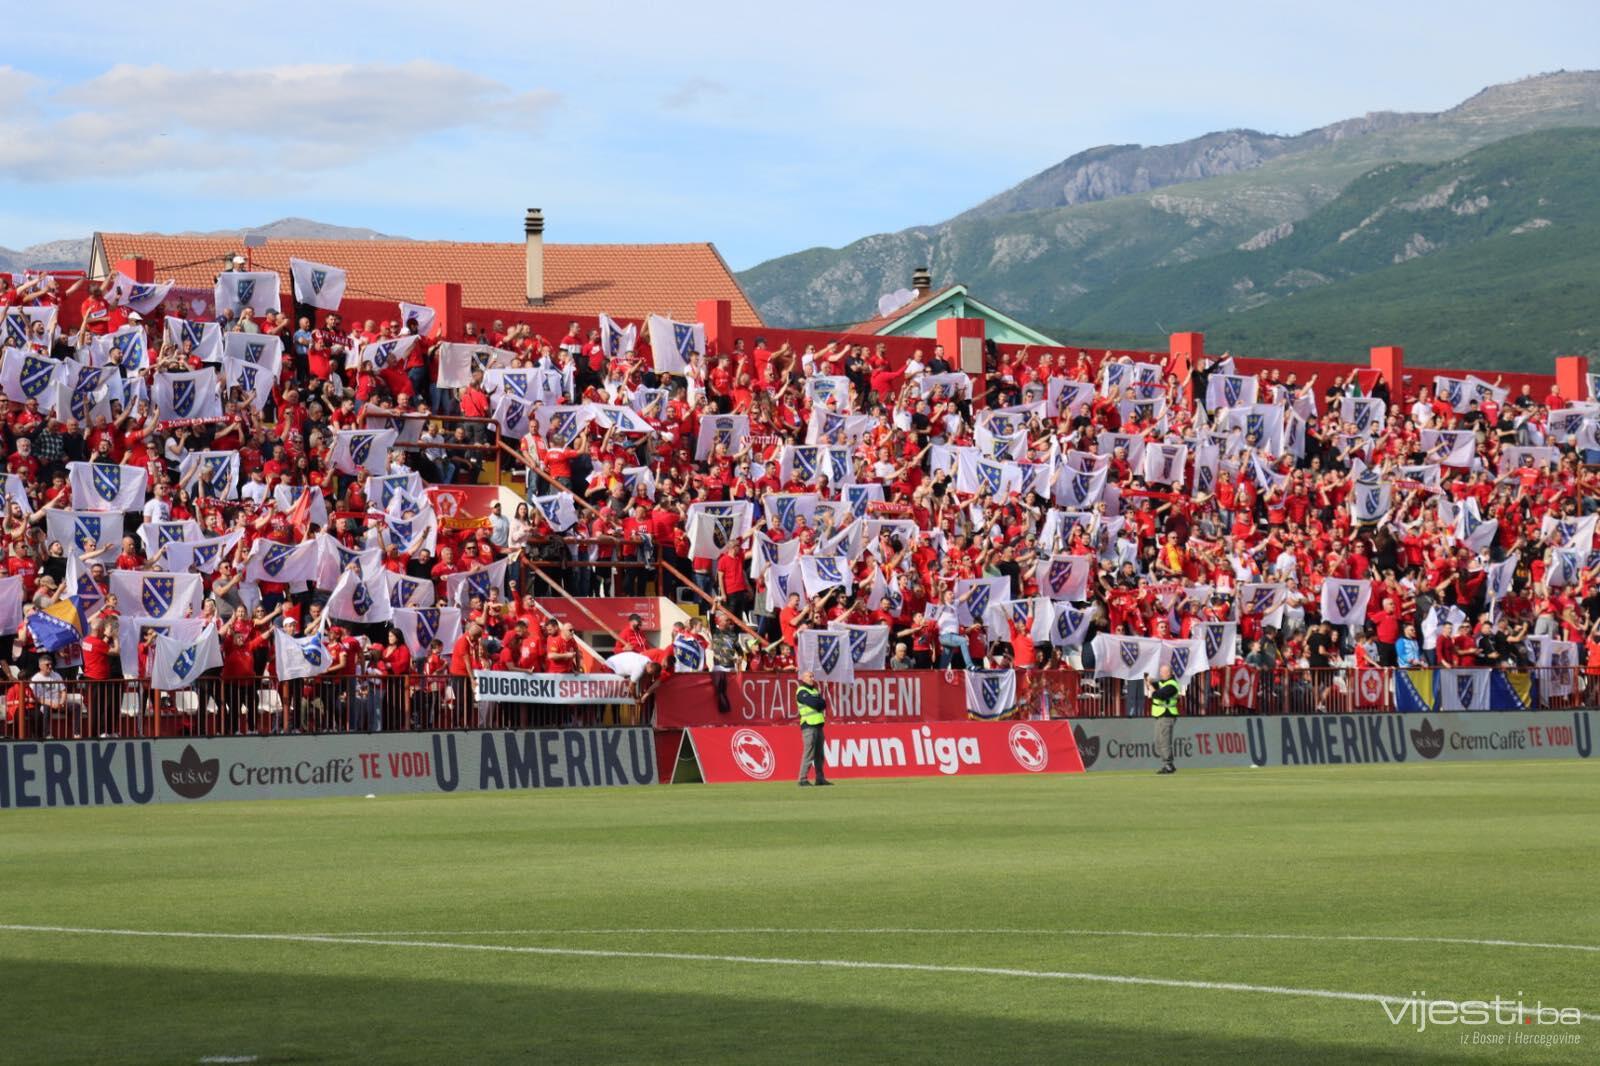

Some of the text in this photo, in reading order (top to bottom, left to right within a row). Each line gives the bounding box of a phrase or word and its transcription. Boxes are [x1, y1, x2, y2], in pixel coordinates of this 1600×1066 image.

[911, 725, 981, 775] liga
[1195, 732, 1212, 755] TE
[1216, 732, 1248, 755] VODI
[1246, 718, 1268, 766] U
[1281, 715, 1408, 765] AMERIKU
[1528, 727, 1542, 748] TE
[1545, 726, 1574, 747] VODI
[1574, 712, 1592, 758] U
[359, 753, 382, 779] TE
[388, 751, 431, 779] VODI
[432, 733, 459, 792] U
[479, 729, 654, 790] AMERIKU
